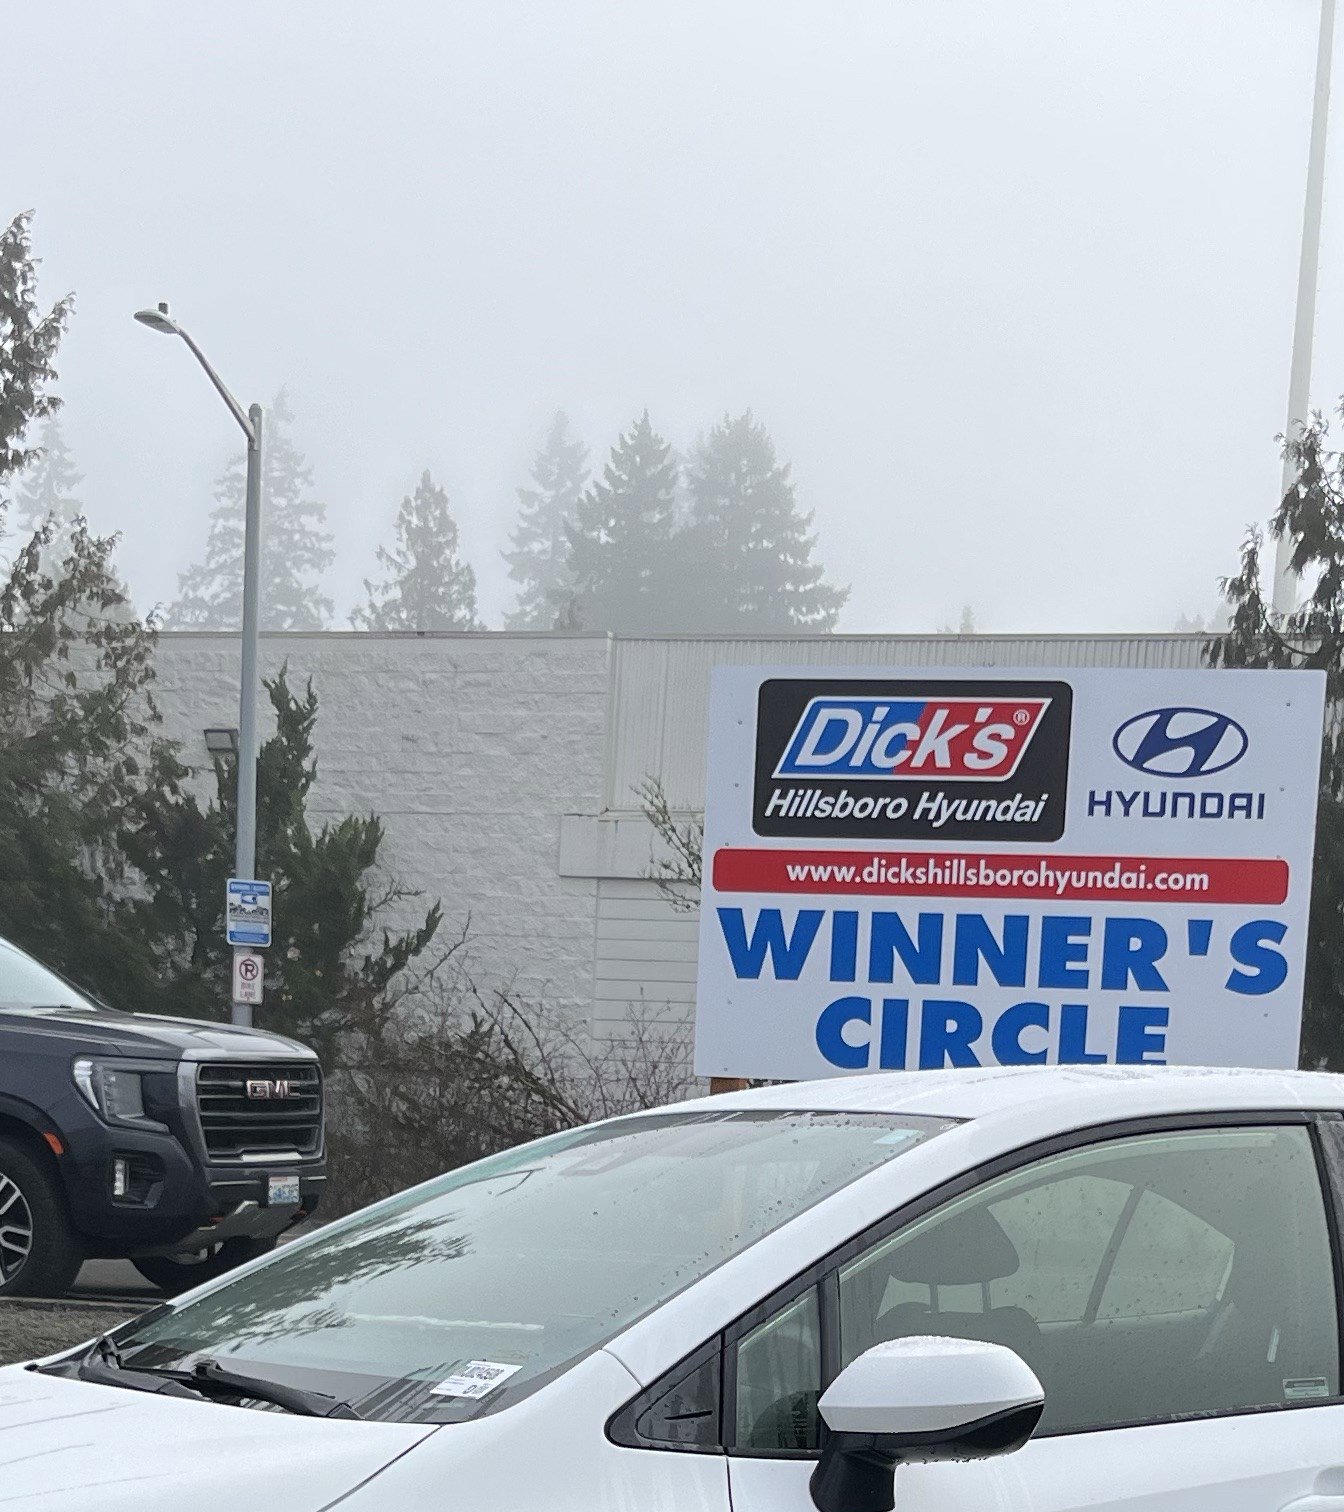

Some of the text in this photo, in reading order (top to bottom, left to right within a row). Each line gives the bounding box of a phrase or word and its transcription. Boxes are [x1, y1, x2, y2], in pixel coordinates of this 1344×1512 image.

[793, 705, 1016, 771] Dick's
[764, 788, 1050, 829] Hillsboro Hyundai
[1087, 789, 1266, 820] HYUNDAI
[785, 857, 1211, 894] www.dickshillsborohyundai.com
[716, 906, 1289, 996] WINNER'S
[815, 997, 1170, 1069] CIRCLE
[246, 1079, 301, 1100] GMC
